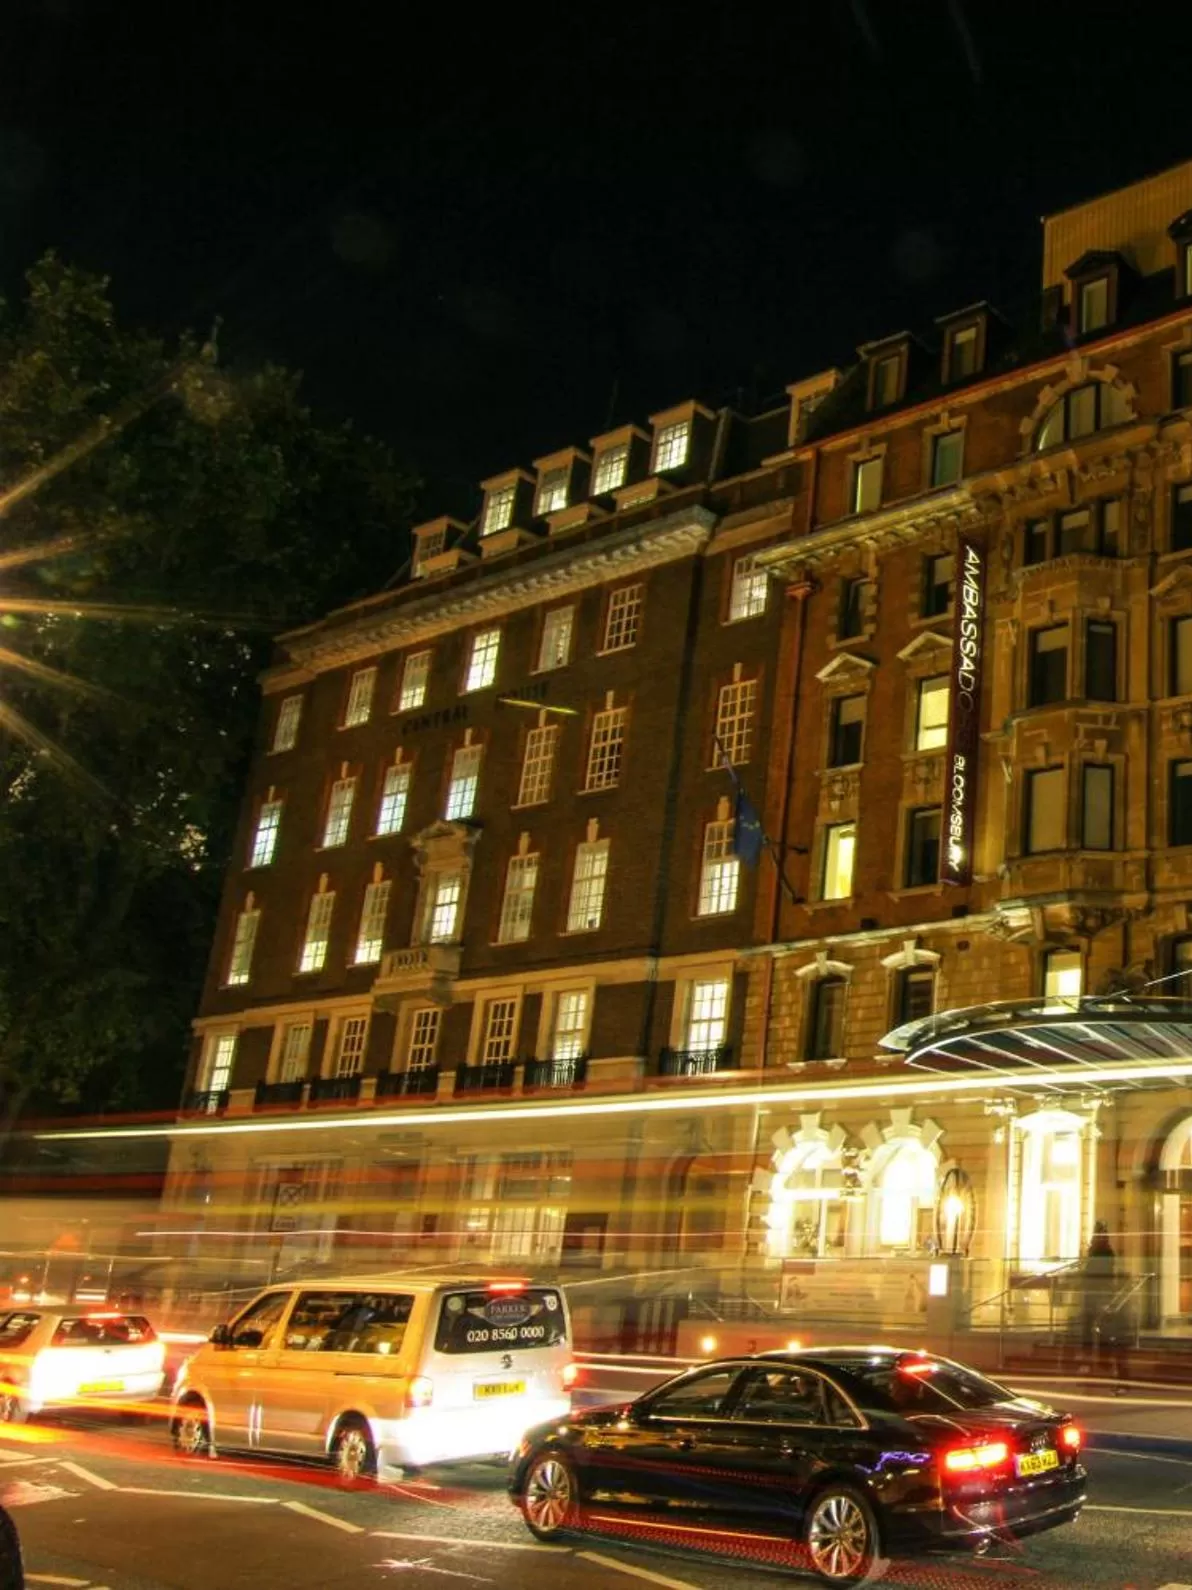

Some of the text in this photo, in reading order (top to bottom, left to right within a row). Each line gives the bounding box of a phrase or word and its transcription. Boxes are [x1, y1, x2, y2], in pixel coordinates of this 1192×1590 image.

[467, 1325, 545, 1342] 020 8560 0000
